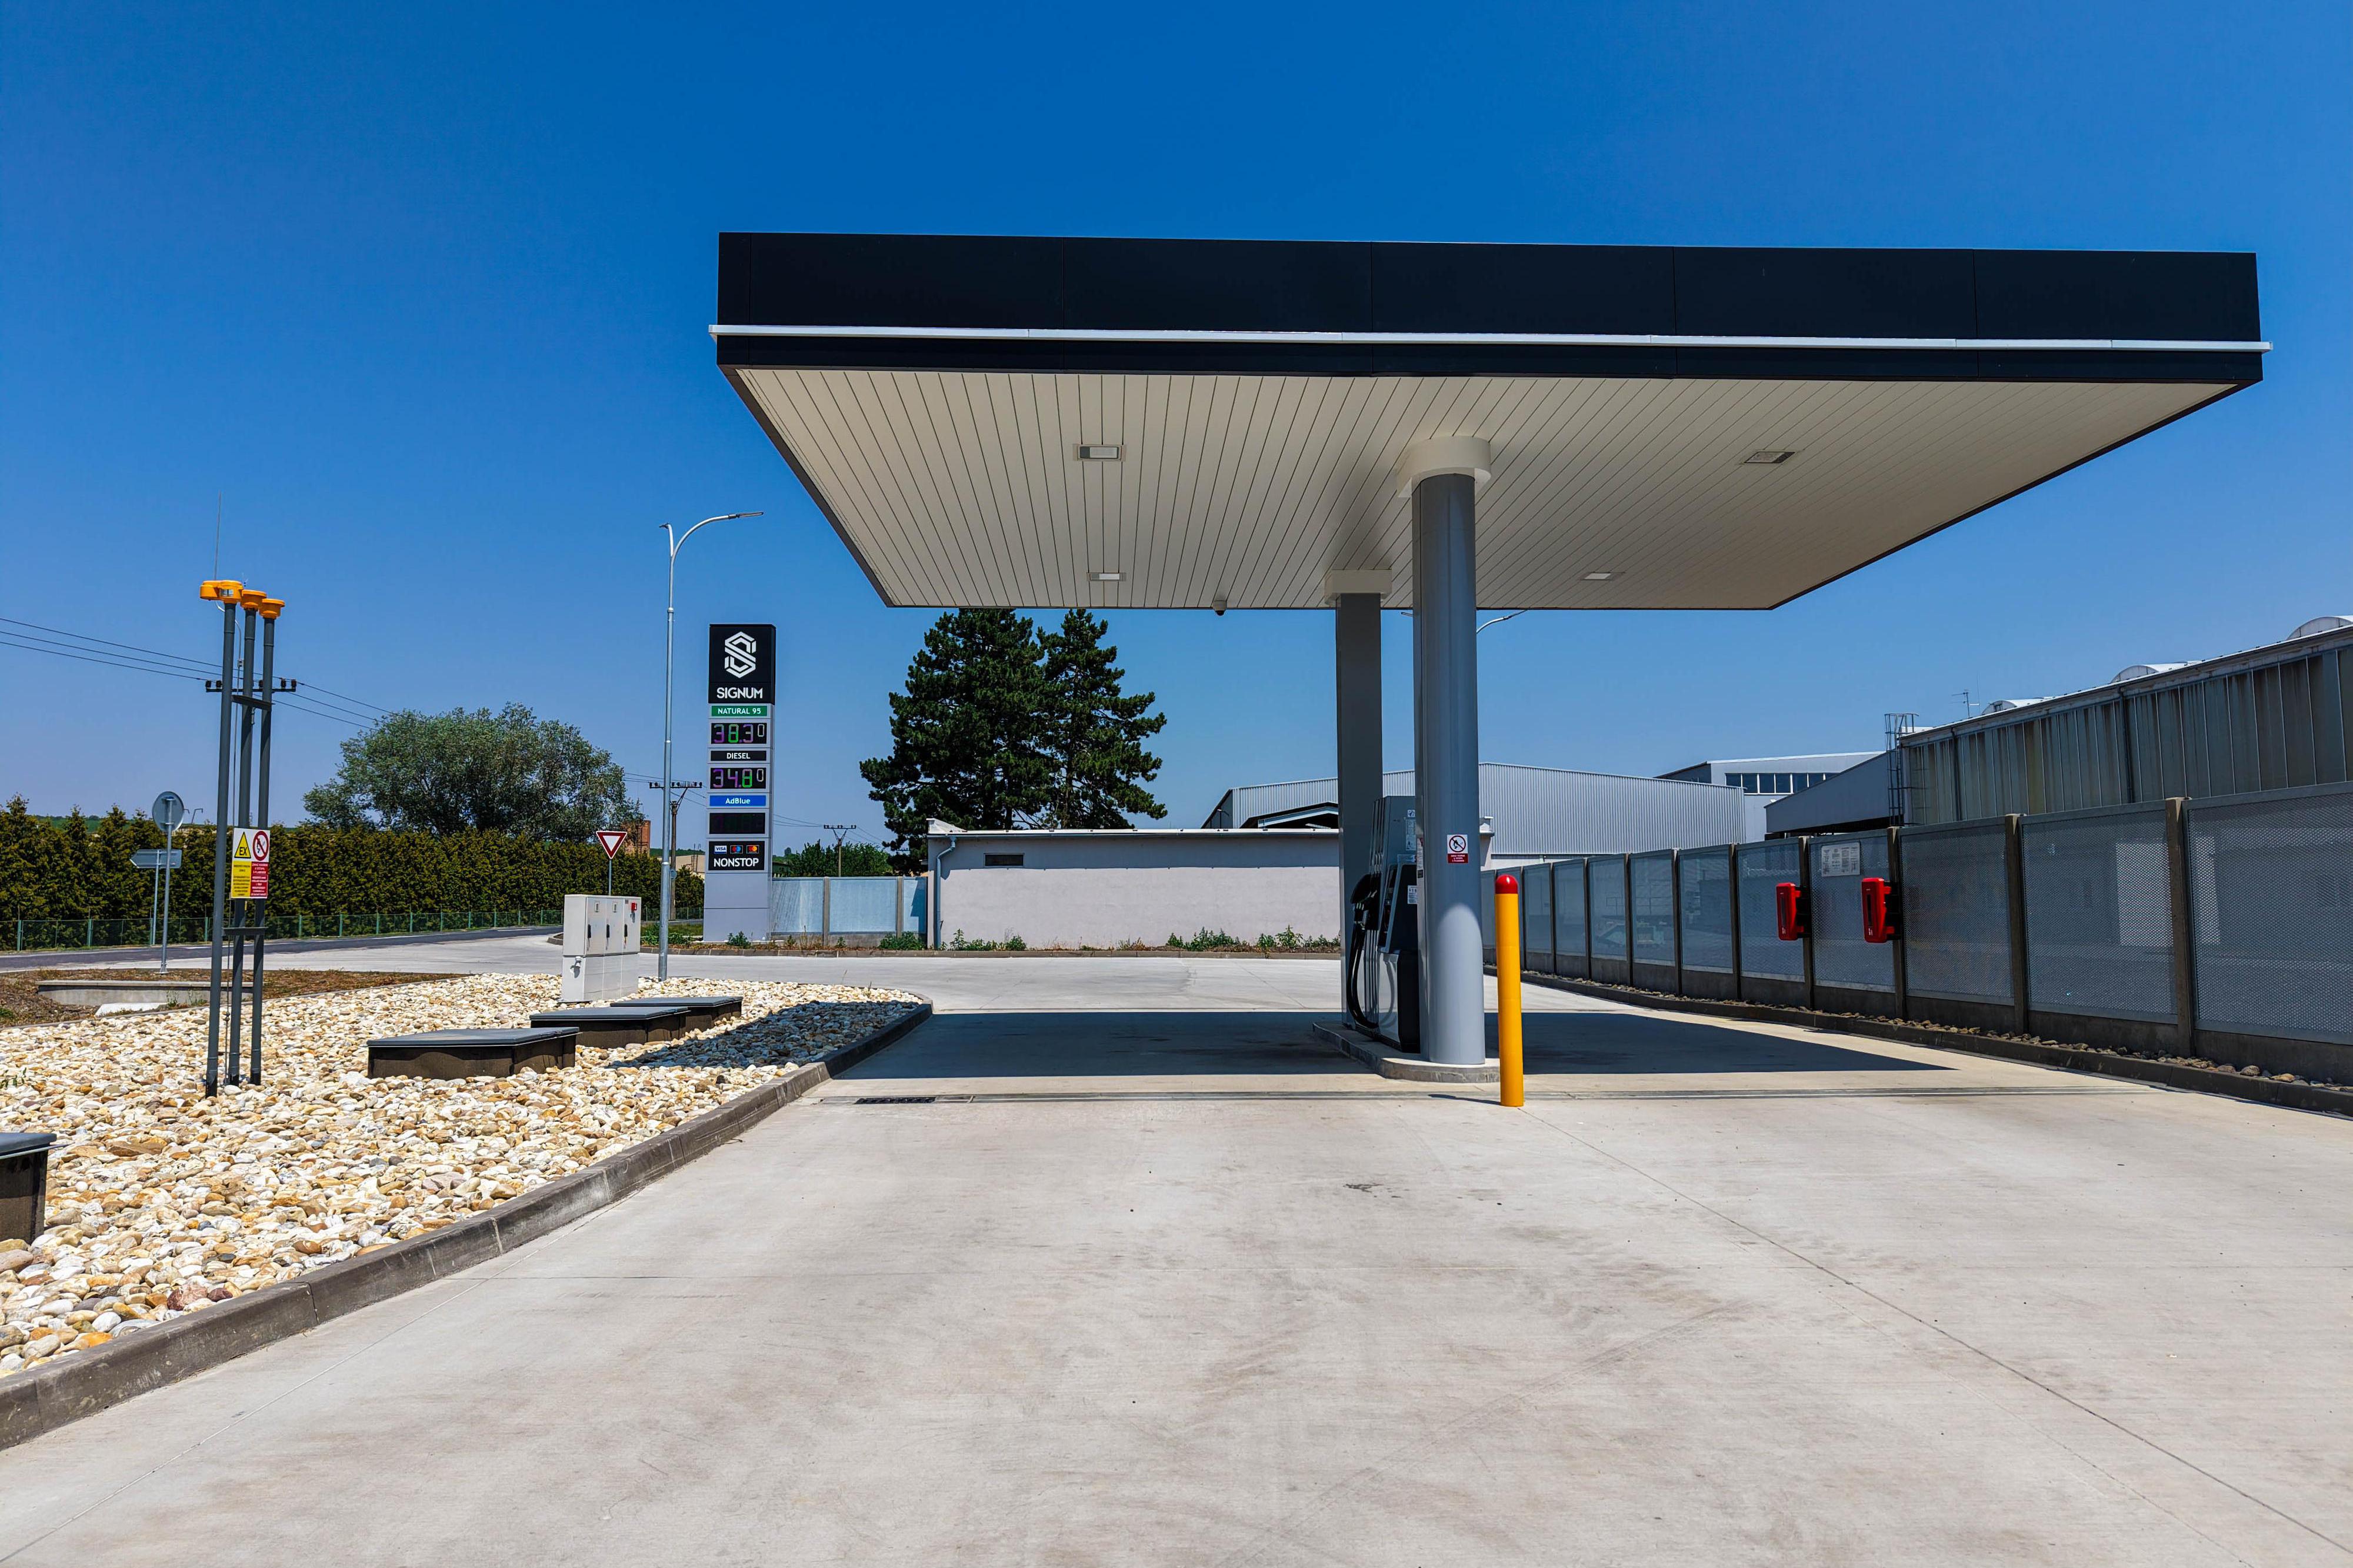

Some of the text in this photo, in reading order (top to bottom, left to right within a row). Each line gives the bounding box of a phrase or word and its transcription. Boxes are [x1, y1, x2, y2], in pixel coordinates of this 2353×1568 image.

[716, 687, 763, 699] SIGNUM
[239, 847, 247, 856] EX
[714, 858, 759, 867] NONSTOP
